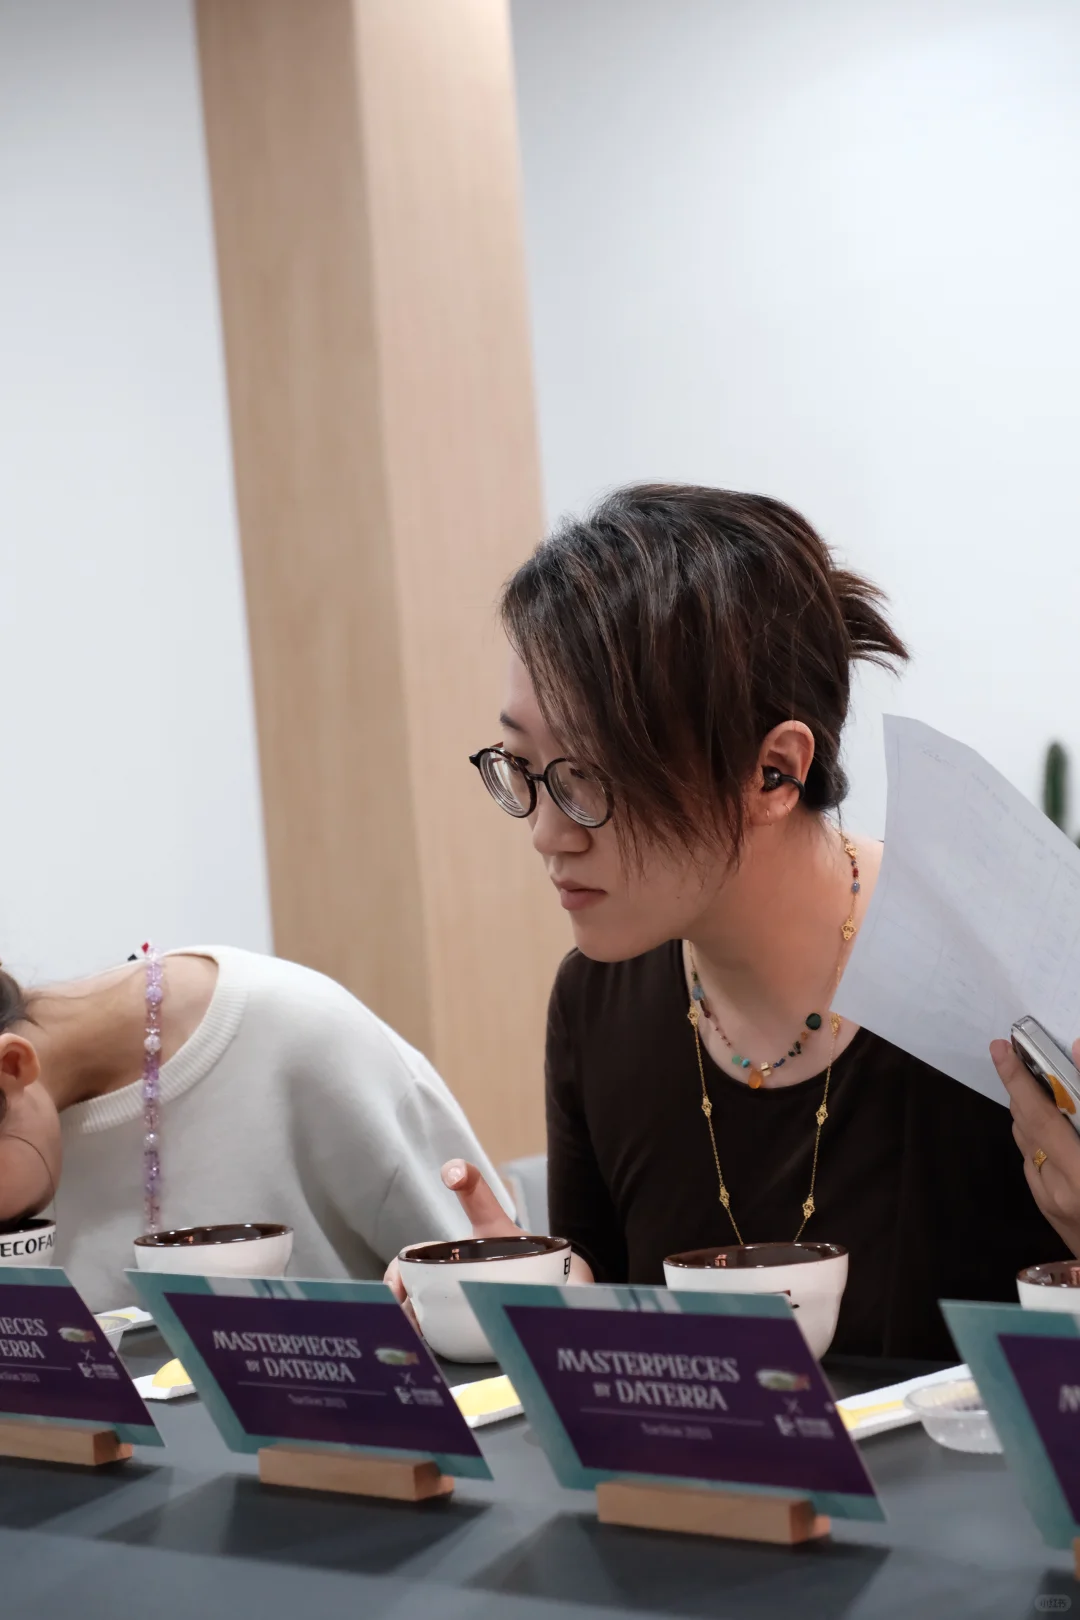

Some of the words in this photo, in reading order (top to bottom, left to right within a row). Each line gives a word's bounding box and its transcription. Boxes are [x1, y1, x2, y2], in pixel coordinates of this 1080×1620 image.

[212, 1330, 362, 1358] MASTERPIECES
[263, 1357, 356, 1383] DATERRA
[557, 1348, 740, 1383] MASTERPIECES
[615, 1379, 728, 1411] DATERRA
